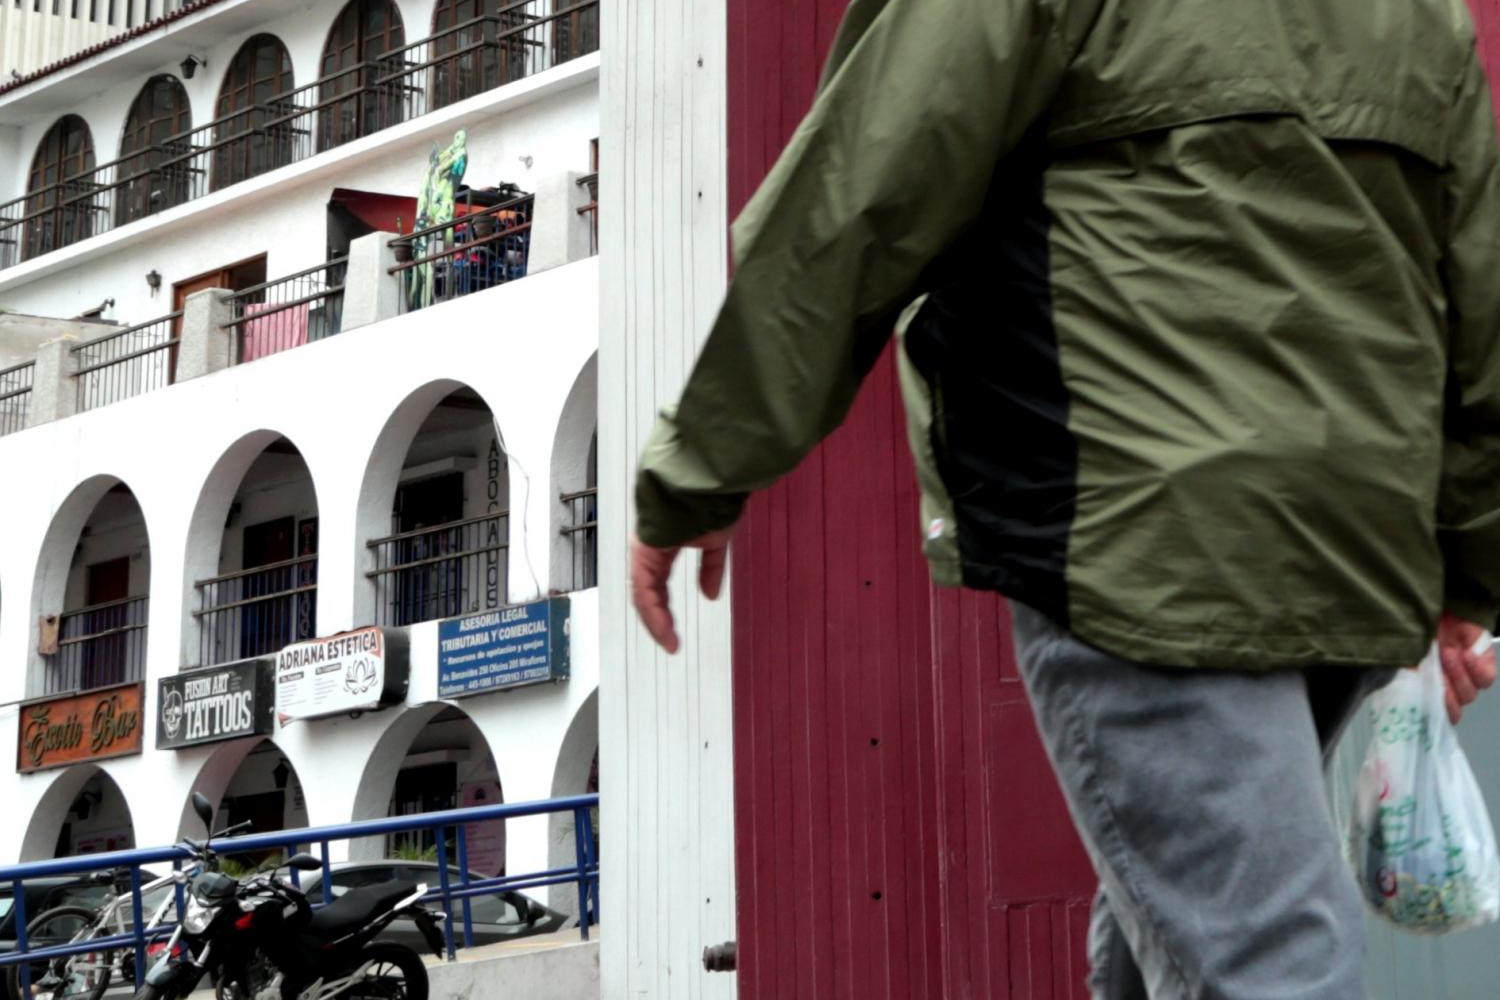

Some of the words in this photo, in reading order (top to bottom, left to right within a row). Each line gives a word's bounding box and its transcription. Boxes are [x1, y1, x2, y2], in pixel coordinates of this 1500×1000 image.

[441, 632, 489, 652] TRIBUTARIA
[491, 630, 498, 642] Y
[499, 620, 547, 640] COMERCIAL
[459, 612, 500, 632] ASESORIA
[501, 607, 528, 624] LEGAL
[279, 643, 324, 672] ADRIANA
[327, 631, 376, 661] ESTETICA
[184, 677, 211, 700] FUSION
[212, 673, 230, 693] ART
[25, 712, 83, 766] Exotic
[91, 695, 137, 753] Bar
[184, 690, 252, 740] TATTOOS
